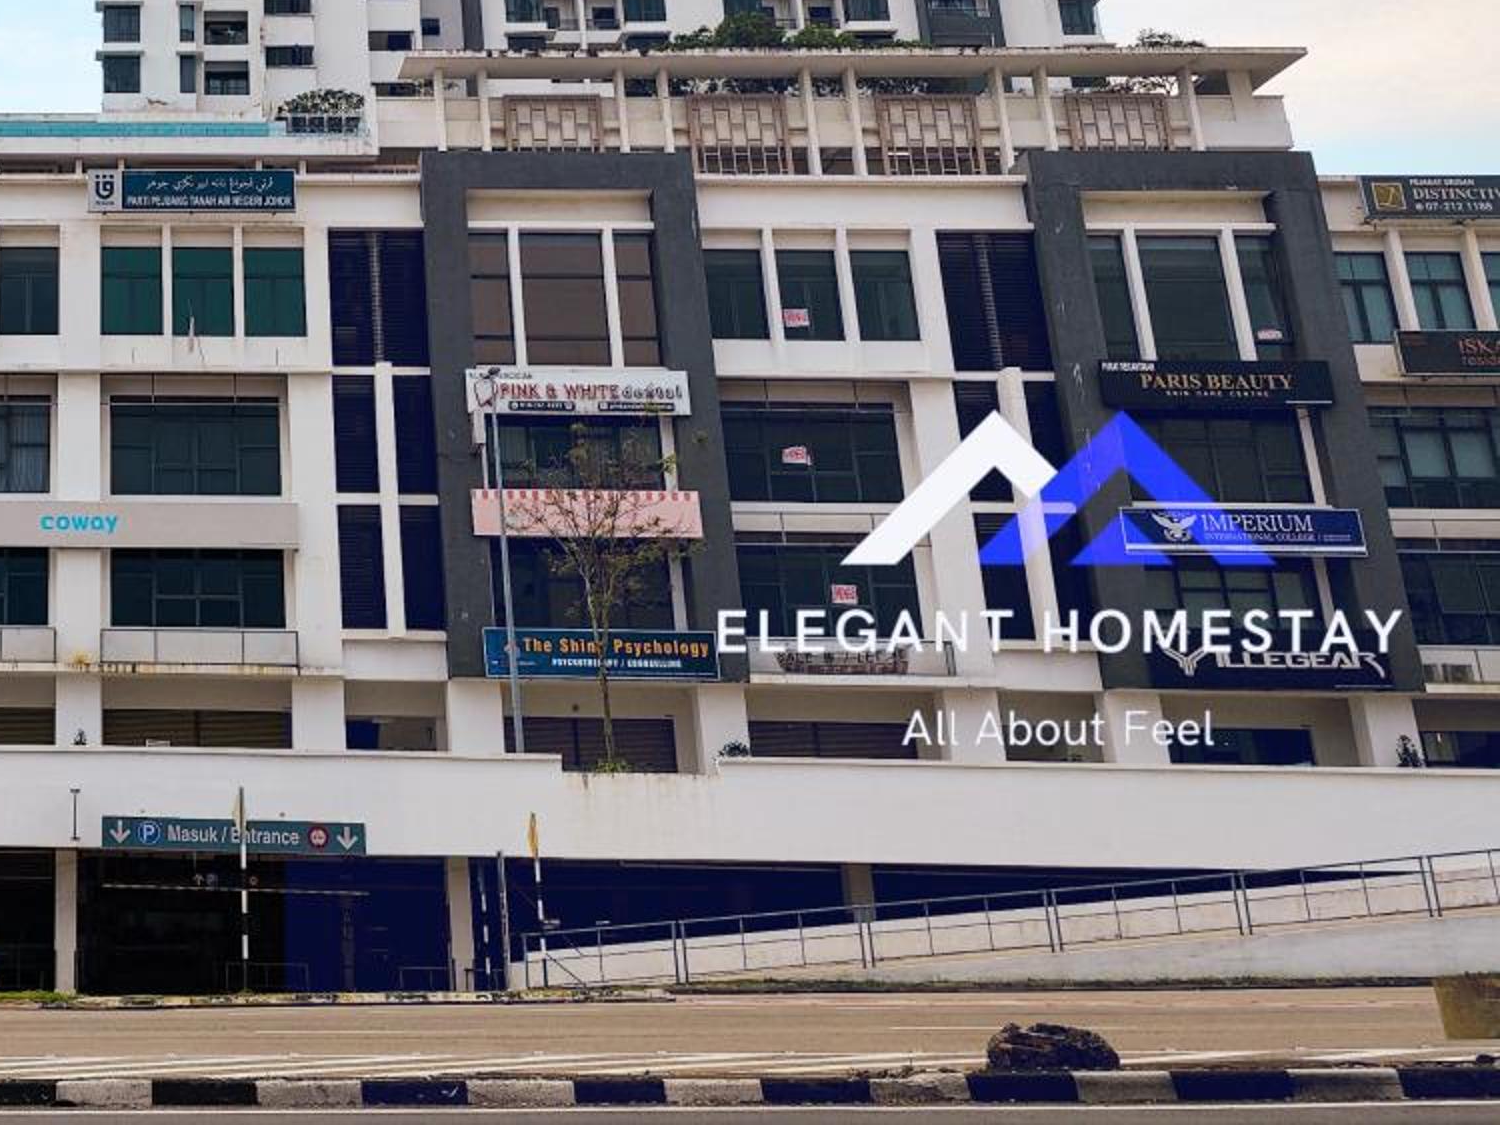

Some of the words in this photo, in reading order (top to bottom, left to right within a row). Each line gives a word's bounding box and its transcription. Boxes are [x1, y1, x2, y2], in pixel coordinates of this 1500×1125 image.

[1140, 373, 1203, 389] PARIS
[1206, 374, 1292, 390] BEAUTY
[500, 383, 542, 400] PINK
[546, 384, 557, 400] &
[563, 384, 620, 400] WHITE
[39, 513, 119, 534] coway
[1202, 514, 1314, 533] IMPERIUM
[1275, 533, 1316, 542] COLLEGE
[523, 637, 551, 653] The
[613, 639, 709, 658] Psychology
[167, 825, 218, 843] Masuk
